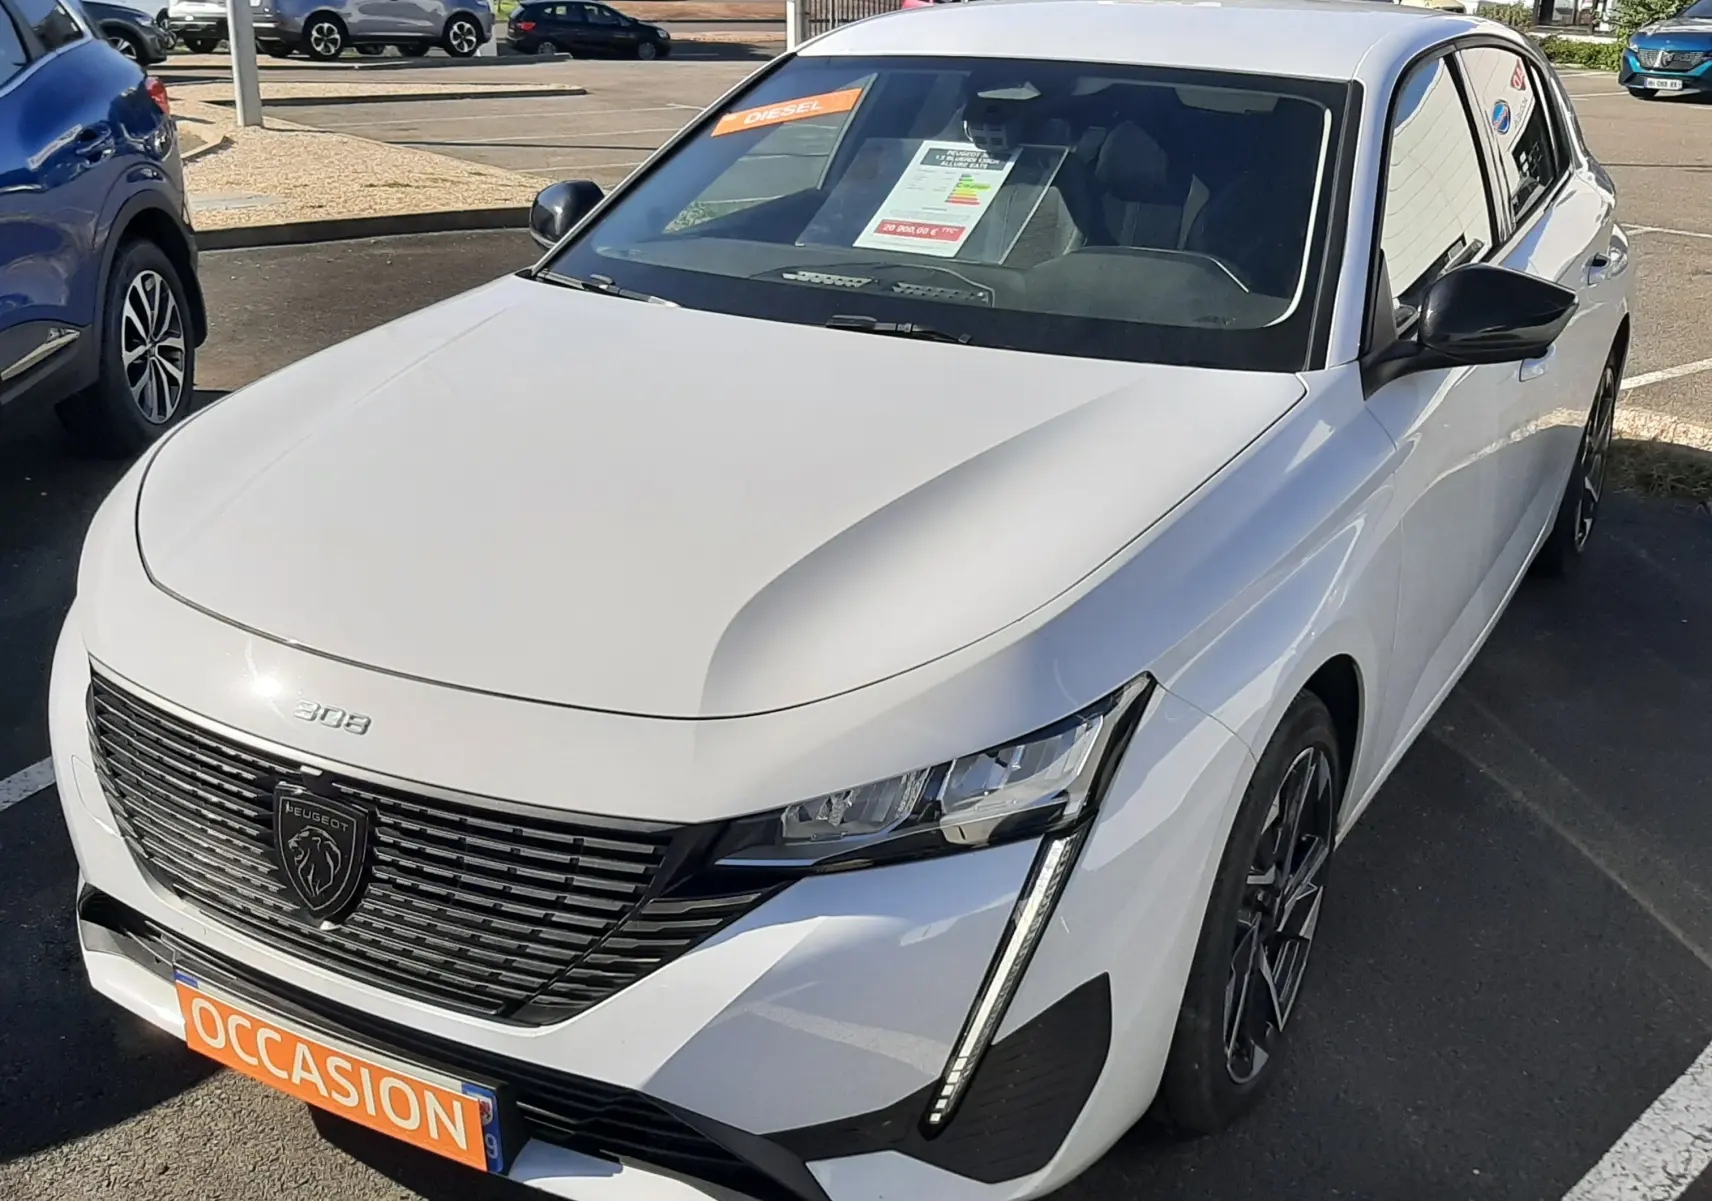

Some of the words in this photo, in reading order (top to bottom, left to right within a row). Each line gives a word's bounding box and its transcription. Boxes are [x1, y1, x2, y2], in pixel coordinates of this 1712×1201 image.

[743, 100, 822, 125] DIESEL
[883, 223, 896, 232] 20
[930, 228, 939, 236] €
[294, 699, 372, 736] 308
[285, 801, 350, 832] PEUGEOT
[191, 997, 467, 1151] OCCASION
